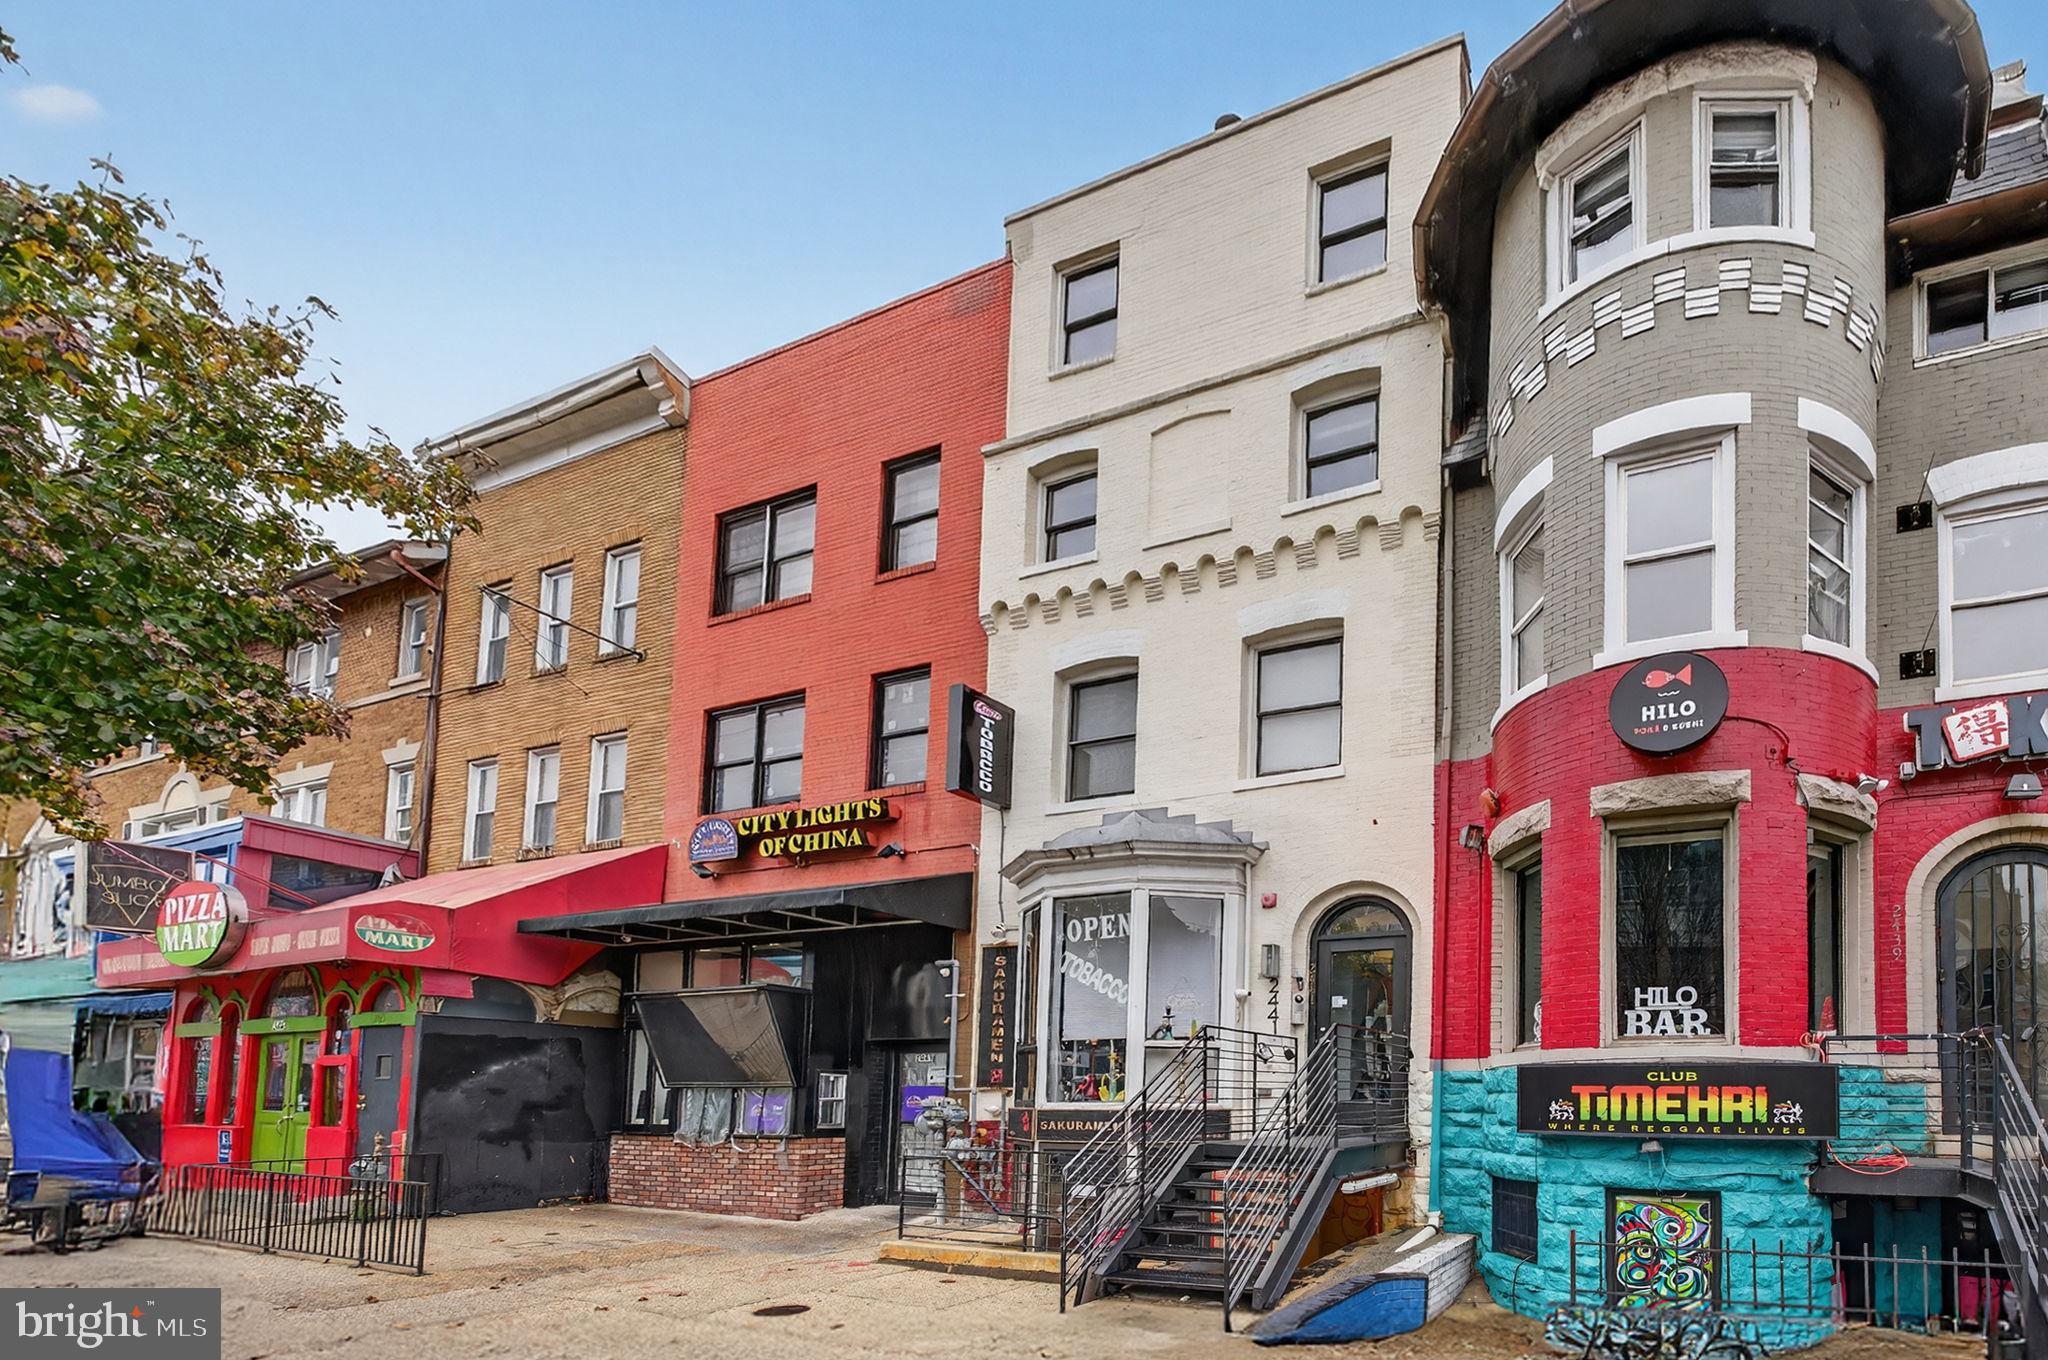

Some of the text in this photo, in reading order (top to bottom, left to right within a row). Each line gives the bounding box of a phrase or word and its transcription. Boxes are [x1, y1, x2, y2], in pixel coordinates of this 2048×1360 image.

[1641, 700, 1696, 722] HILO
[979, 715, 996, 793] TOBACCO
[737, 797, 882, 836] CITY LIGHTS
[758, 837, 786, 858] OF
[788, 827, 863, 853] CHINA
[164, 892, 227, 925] PIZZA
[162, 921, 222, 953] MART
[365, 930, 426, 950] MART
[1066, 912, 1131, 943] OPEN
[991, 956, 1007, 1063] SAKURAMEN
[1634, 985, 1698, 1007] HILO
[1624, 1008, 1711, 1037] BAR
[1647, 1071, 1698, 1082] CLUB
[1548, 1122, 1806, 1135] WHERE REGGAE LIVES
